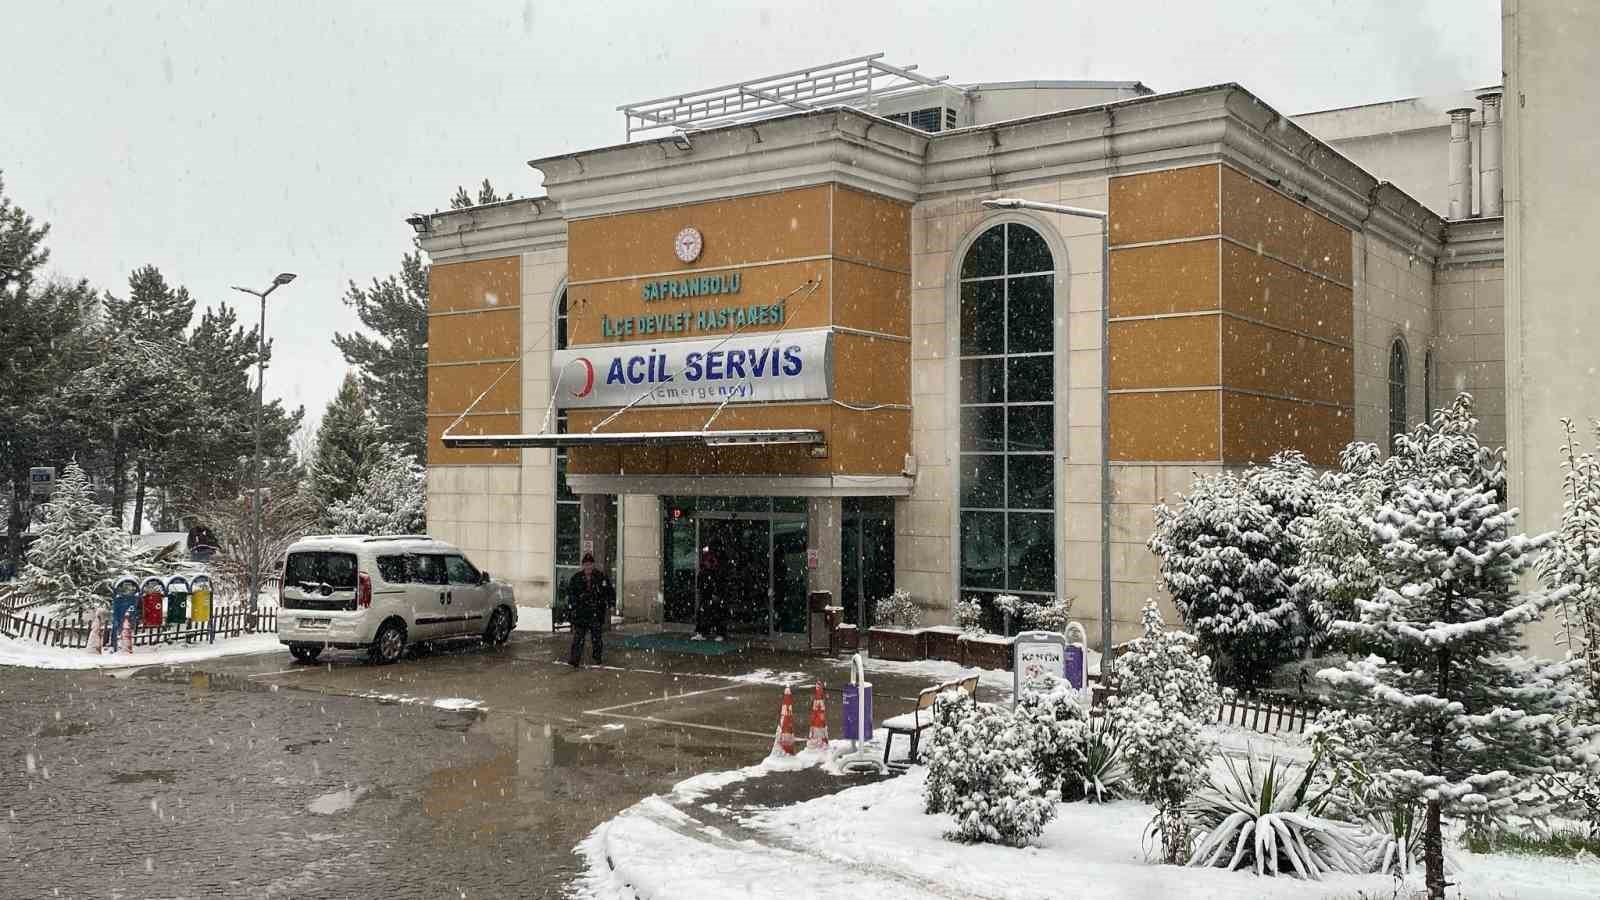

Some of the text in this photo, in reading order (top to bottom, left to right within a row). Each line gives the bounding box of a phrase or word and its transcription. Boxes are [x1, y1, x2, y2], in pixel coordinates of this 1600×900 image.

[643, 273, 741, 301] SAFRANBOLU
[639, 311, 692, 334] DEVLET
[697, 300, 785, 330] HASTANESİ
[606, 349, 674, 385] ACİL
